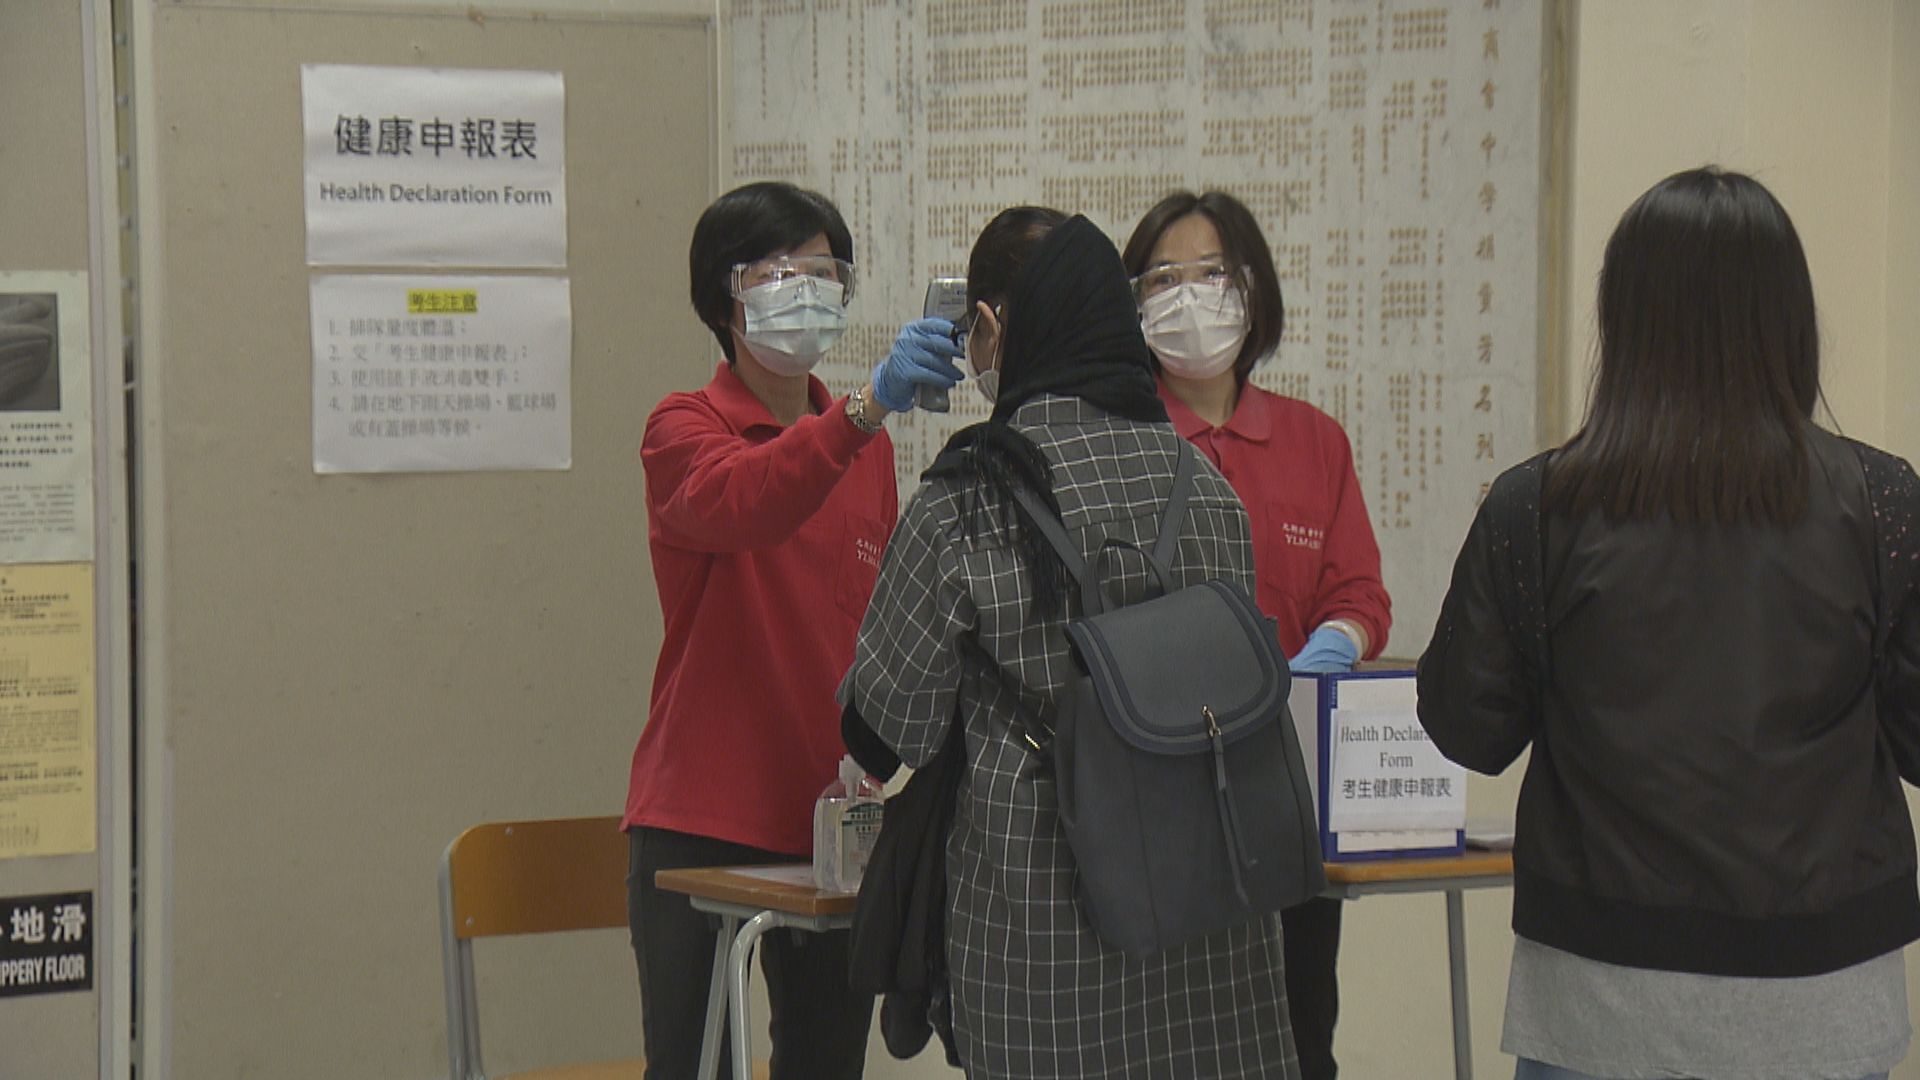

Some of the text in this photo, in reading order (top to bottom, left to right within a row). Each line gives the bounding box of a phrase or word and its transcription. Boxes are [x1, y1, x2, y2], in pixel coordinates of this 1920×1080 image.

[334, 115, 537, 160] 健康申報表
[320, 182, 552, 205] Health Declaration Form
[1341, 726, 1379, 743] Health
[1379, 752, 1413, 768] Form
[1342, 778, 1452, 799] 考生健康申報表
[0, 904, 87, 943] 地滑
[0, 953, 86, 986] PPERY FLOOR
